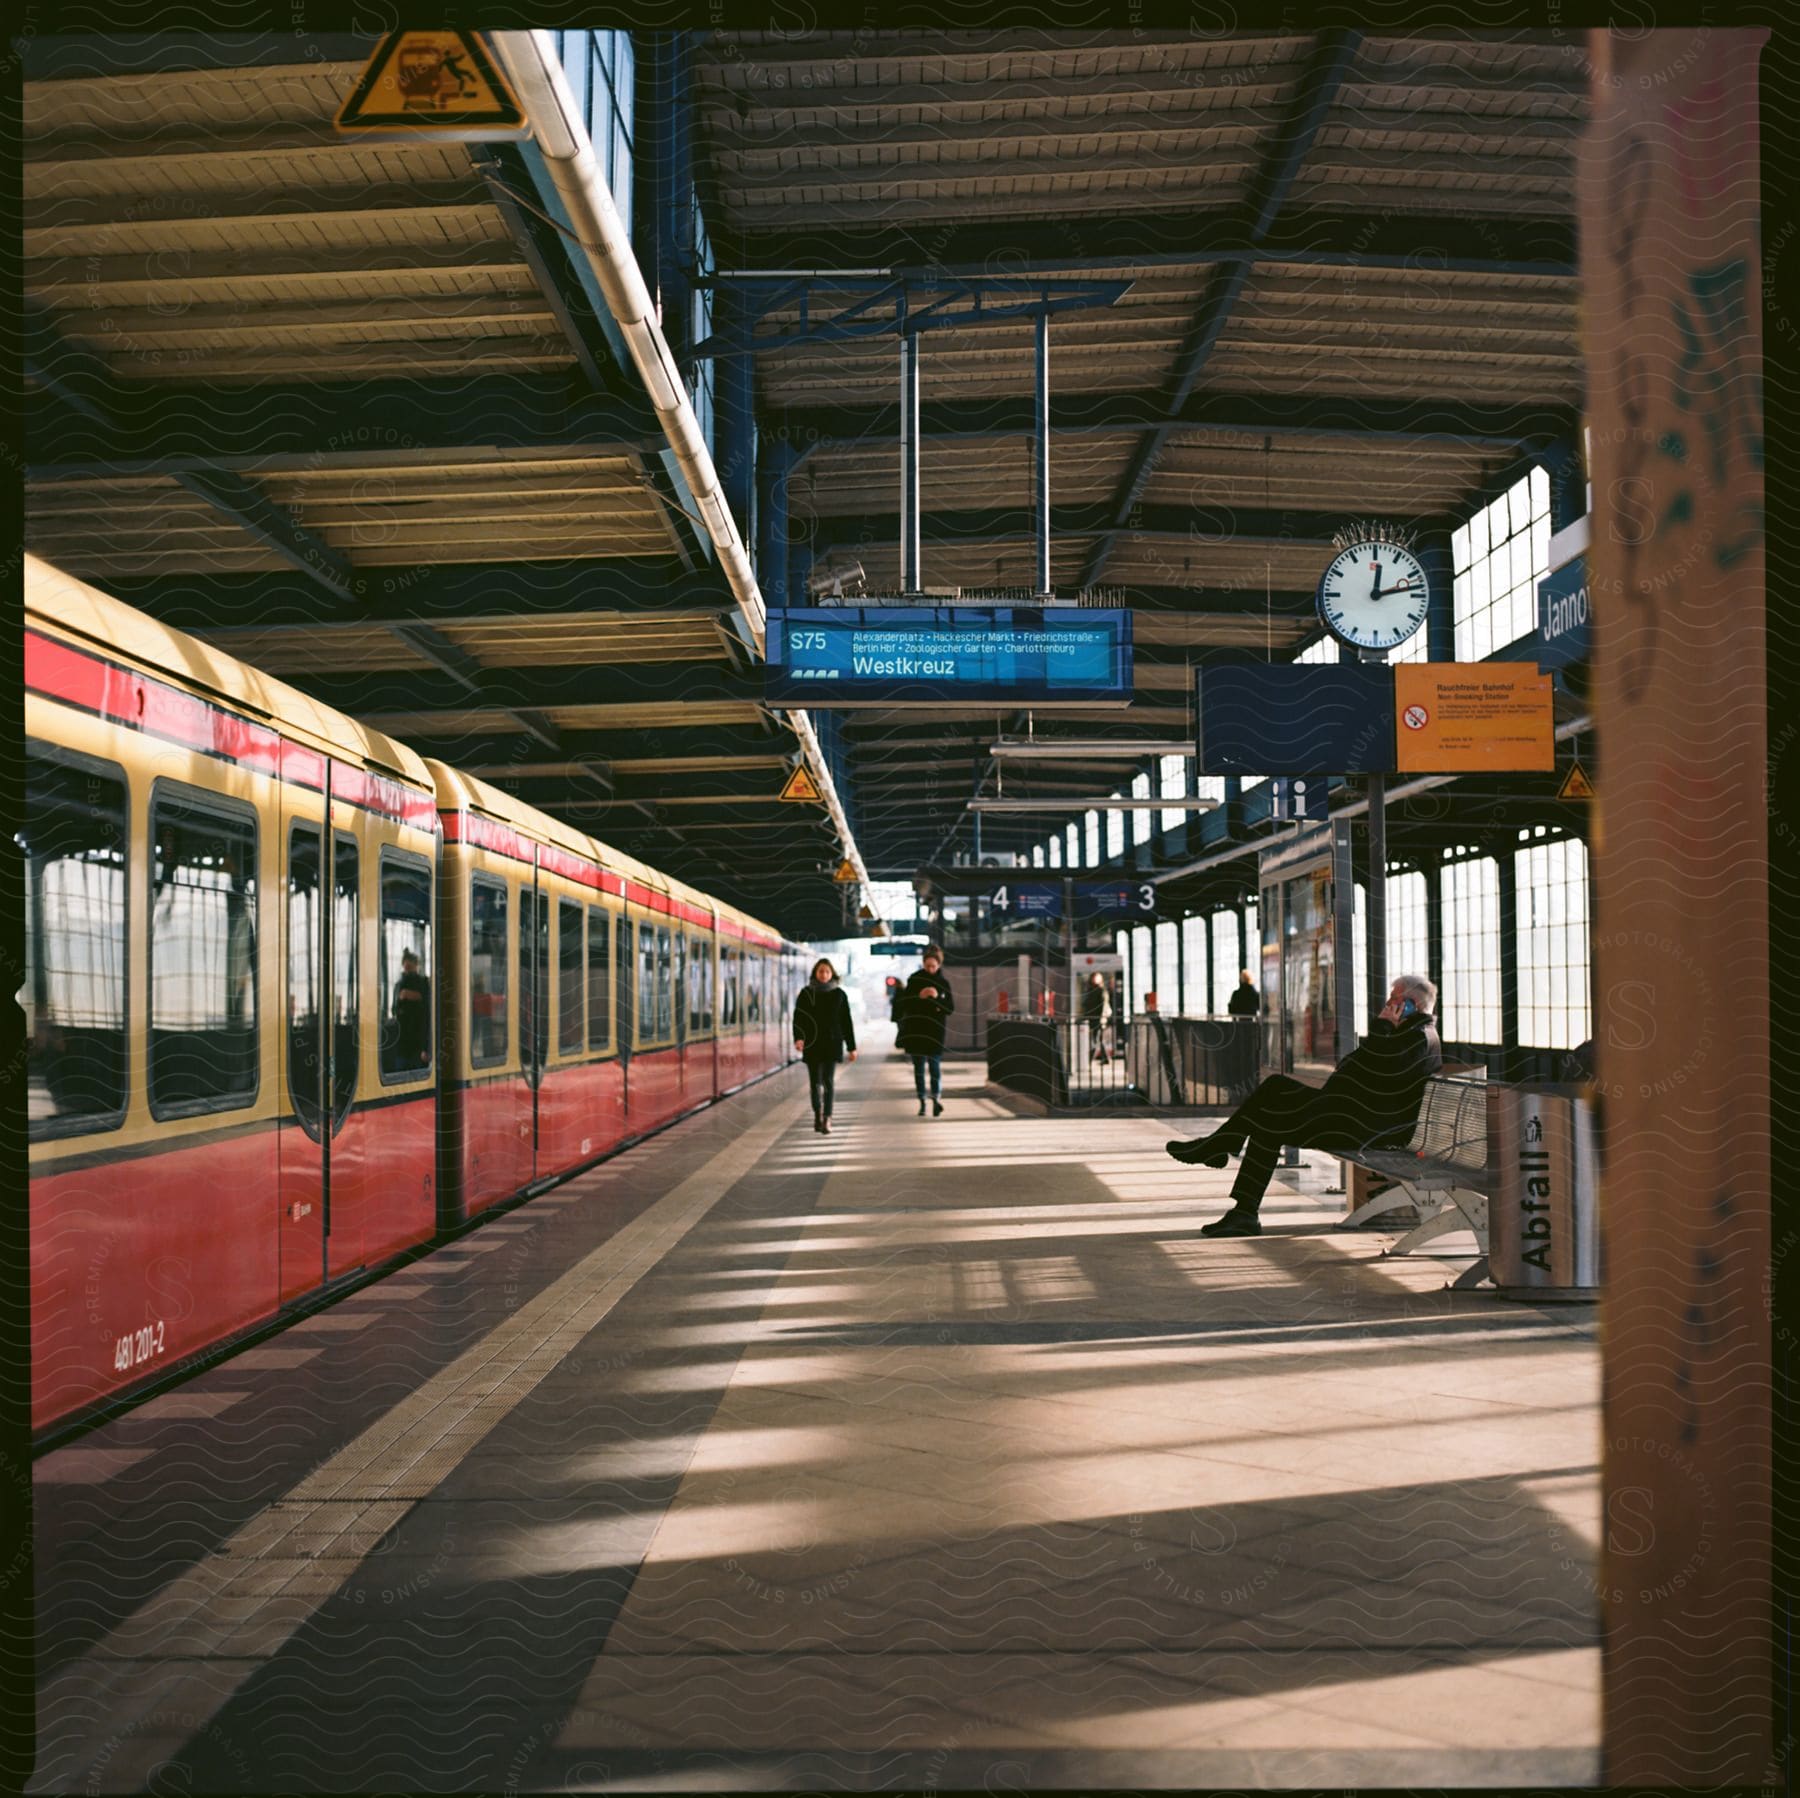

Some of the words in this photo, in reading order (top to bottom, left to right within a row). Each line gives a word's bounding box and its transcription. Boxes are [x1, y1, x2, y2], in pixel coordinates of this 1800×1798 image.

[790, 632, 826, 650] S75
[853, 632, 924, 643] Alexanderplatz
[932, 632, 986, 642] Hackescher
[988, 632, 1015, 642] Markt
[1024, 632, 1093, 642] Friedrichstraße
[853, 644, 879, 652] Berlin
[880, 644, 896, 652] Hbf
[904, 644, 962, 655] Zoologischer
[964, 644, 996, 652] Garten
[1004, 644, 1076, 655] Charlottenburg
[853, 656, 955, 674] Westkreuz
[992, 885, 1010, 911] 4
[1138, 884, 1155, 910] 3
[1520, 1151, 1552, 1272] Abfall
[115, 1333, 133, 1371] 481
[136, 1320, 164, 1364] 201-2
